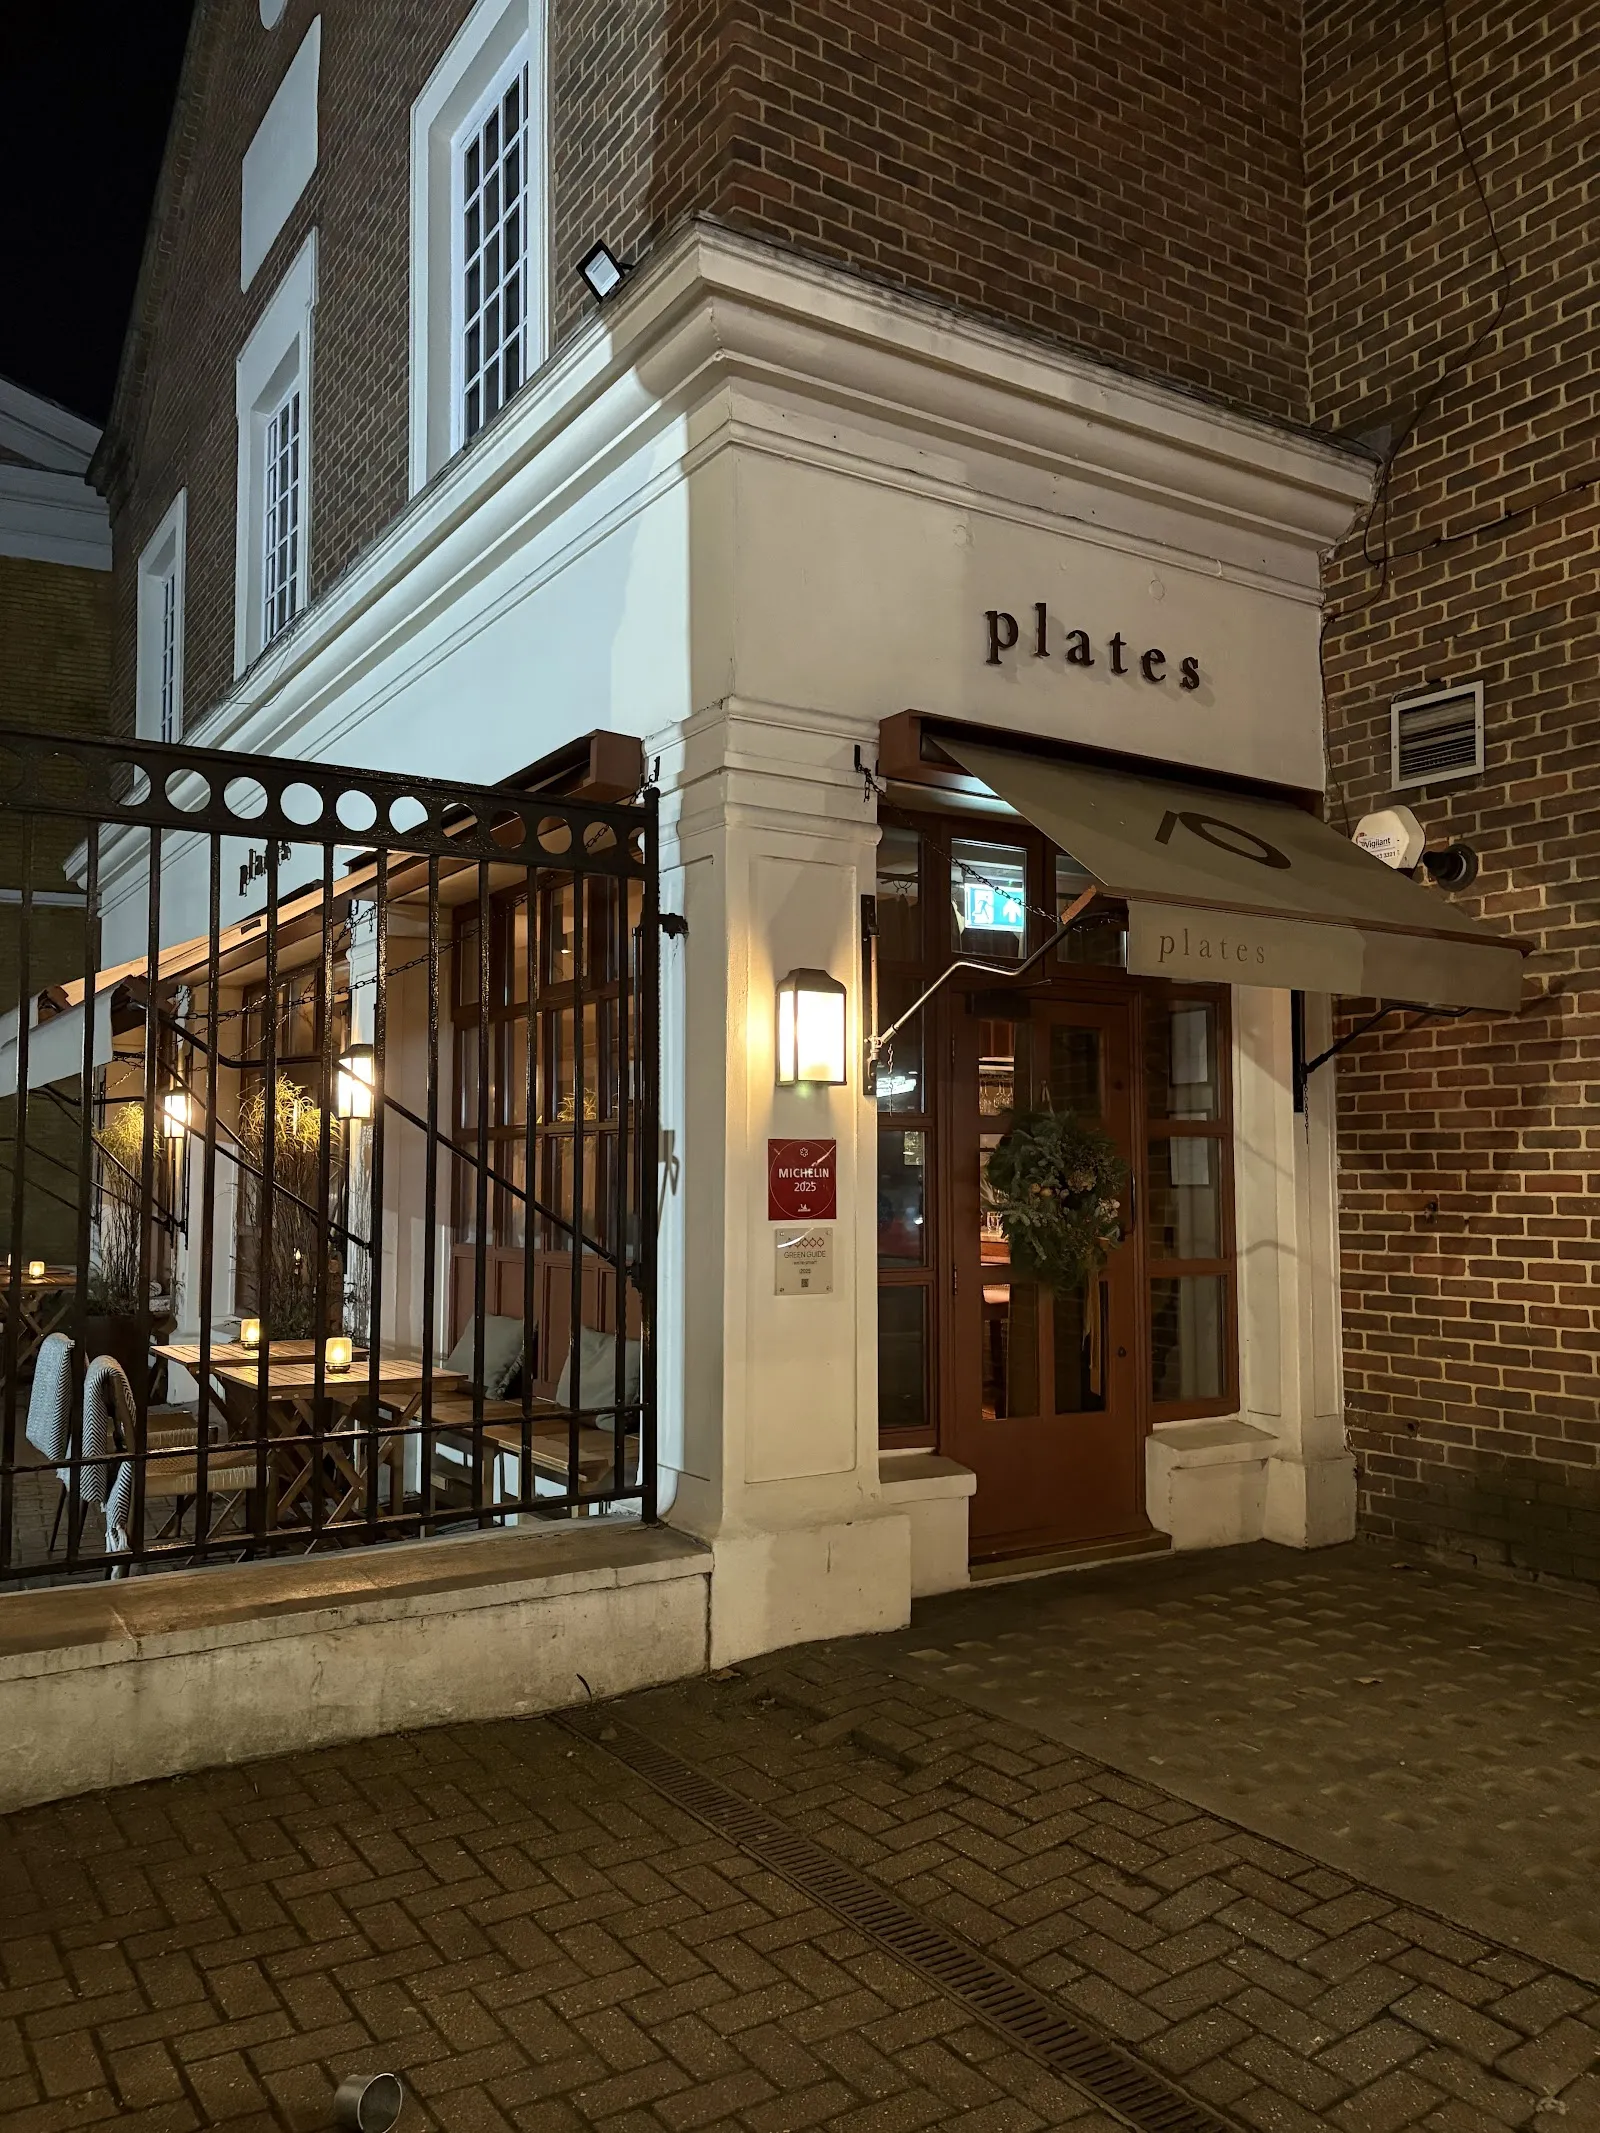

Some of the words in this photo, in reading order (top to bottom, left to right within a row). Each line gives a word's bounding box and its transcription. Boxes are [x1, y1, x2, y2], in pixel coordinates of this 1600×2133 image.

[984, 602, 1200, 690] plates
[1364, 838, 1391, 849] Vigilant
[1157, 928, 1265, 964] plates
[778, 1168, 830, 1178] MICHELIN
[794, 1181, 817, 1192] 2025
[784, 1251, 805, 1259] GREEN
[806, 1250, 826, 1258] GUIDE
